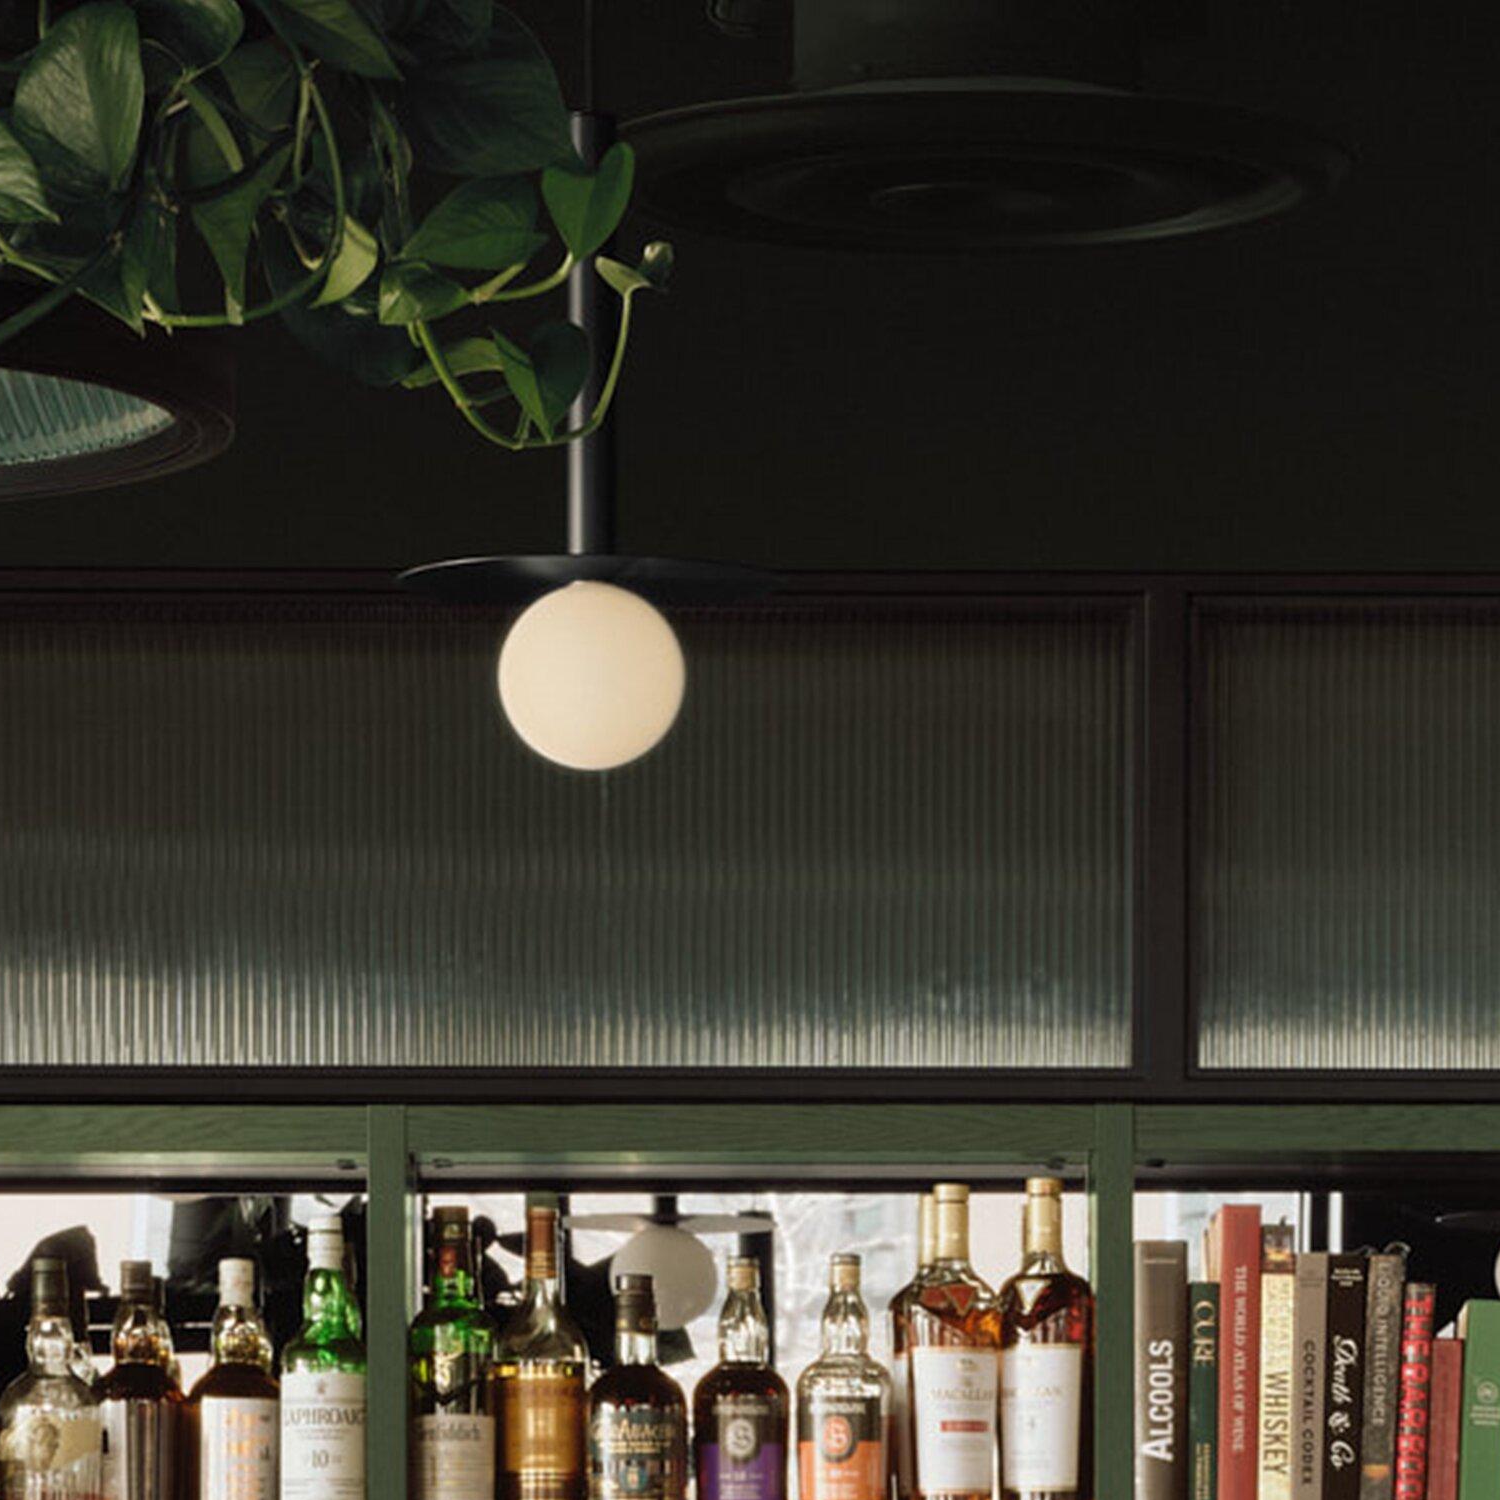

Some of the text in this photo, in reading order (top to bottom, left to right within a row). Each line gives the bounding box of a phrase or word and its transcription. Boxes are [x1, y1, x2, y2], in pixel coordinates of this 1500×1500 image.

[1192, 1301, 1216, 1366] CURE
[1231, 1265, 1247, 1451] THE WORLD ATLAS OF WINE
[1371, 1261, 1392, 1426] LIQUID INTELLIGENCE
[1403, 1294, 1434, 1360] THE
[1143, 1338, 1174, 1462] ALCOOLS
[1333, 1335, 1357, 1404] Death
[1399, 1363, 1429, 1430] BAR
[1263, 1371, 1290, 1476] WHISKEY
[1301, 1339, 1315, 1485] COCKTAIL CODEX
[1328, 1411, 1351, 1435] &
[311, 1450, 329, 1469] 10
